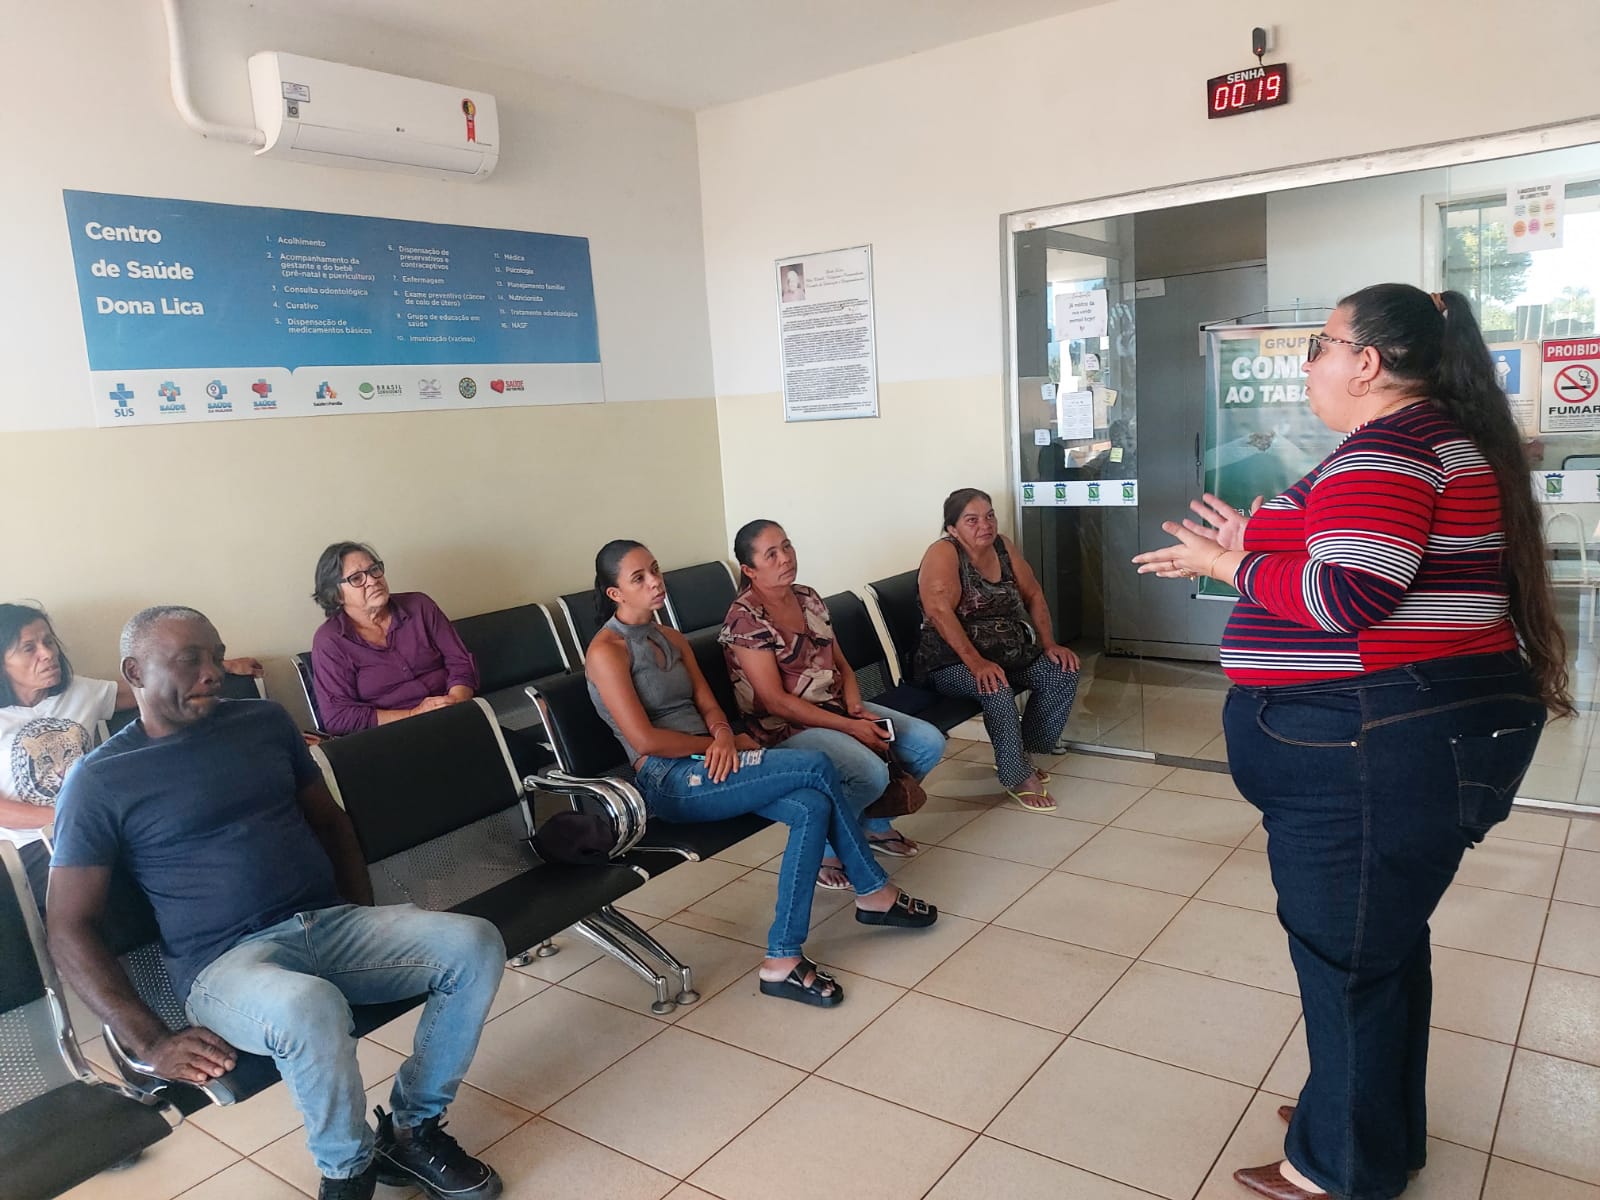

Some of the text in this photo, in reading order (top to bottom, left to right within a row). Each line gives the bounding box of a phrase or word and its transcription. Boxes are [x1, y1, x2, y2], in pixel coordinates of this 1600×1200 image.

[1227, 68, 1266, 84] SENHA
[1214, 75, 1281, 111] 0019
[85, 222, 162, 244] Centro
[278, 237, 326, 247] Acolhimento
[399, 246, 440, 256] Dispensação
[280, 254, 349, 264] Acompanhamento
[400, 254, 444, 262] preservativos
[91, 260, 194, 280] de Saúde
[281, 262, 315, 270] gestante
[336, 264, 353, 272] bebê
[401, 262, 449, 270] contraceptivos
[282, 270, 320, 279] (pré-natal
[329, 272, 375, 282] puericultura)
[402, 276, 444, 284] Enfermagem
[284, 286, 318, 294] Consulta
[320, 287, 368, 297] odontológica
[429, 292, 461, 300] preventivo
[96, 297, 204, 316] Dona Lica
[286, 302, 319, 310] Curativo
[407, 313, 428, 321] Grupo
[288, 318, 336, 327] Dispensação
[1265, 337, 1308, 349] GRUP
[1547, 343, 1600, 357] PROIBID
[1225, 386, 1255, 403] AO
[114, 408, 135, 418] SUS
